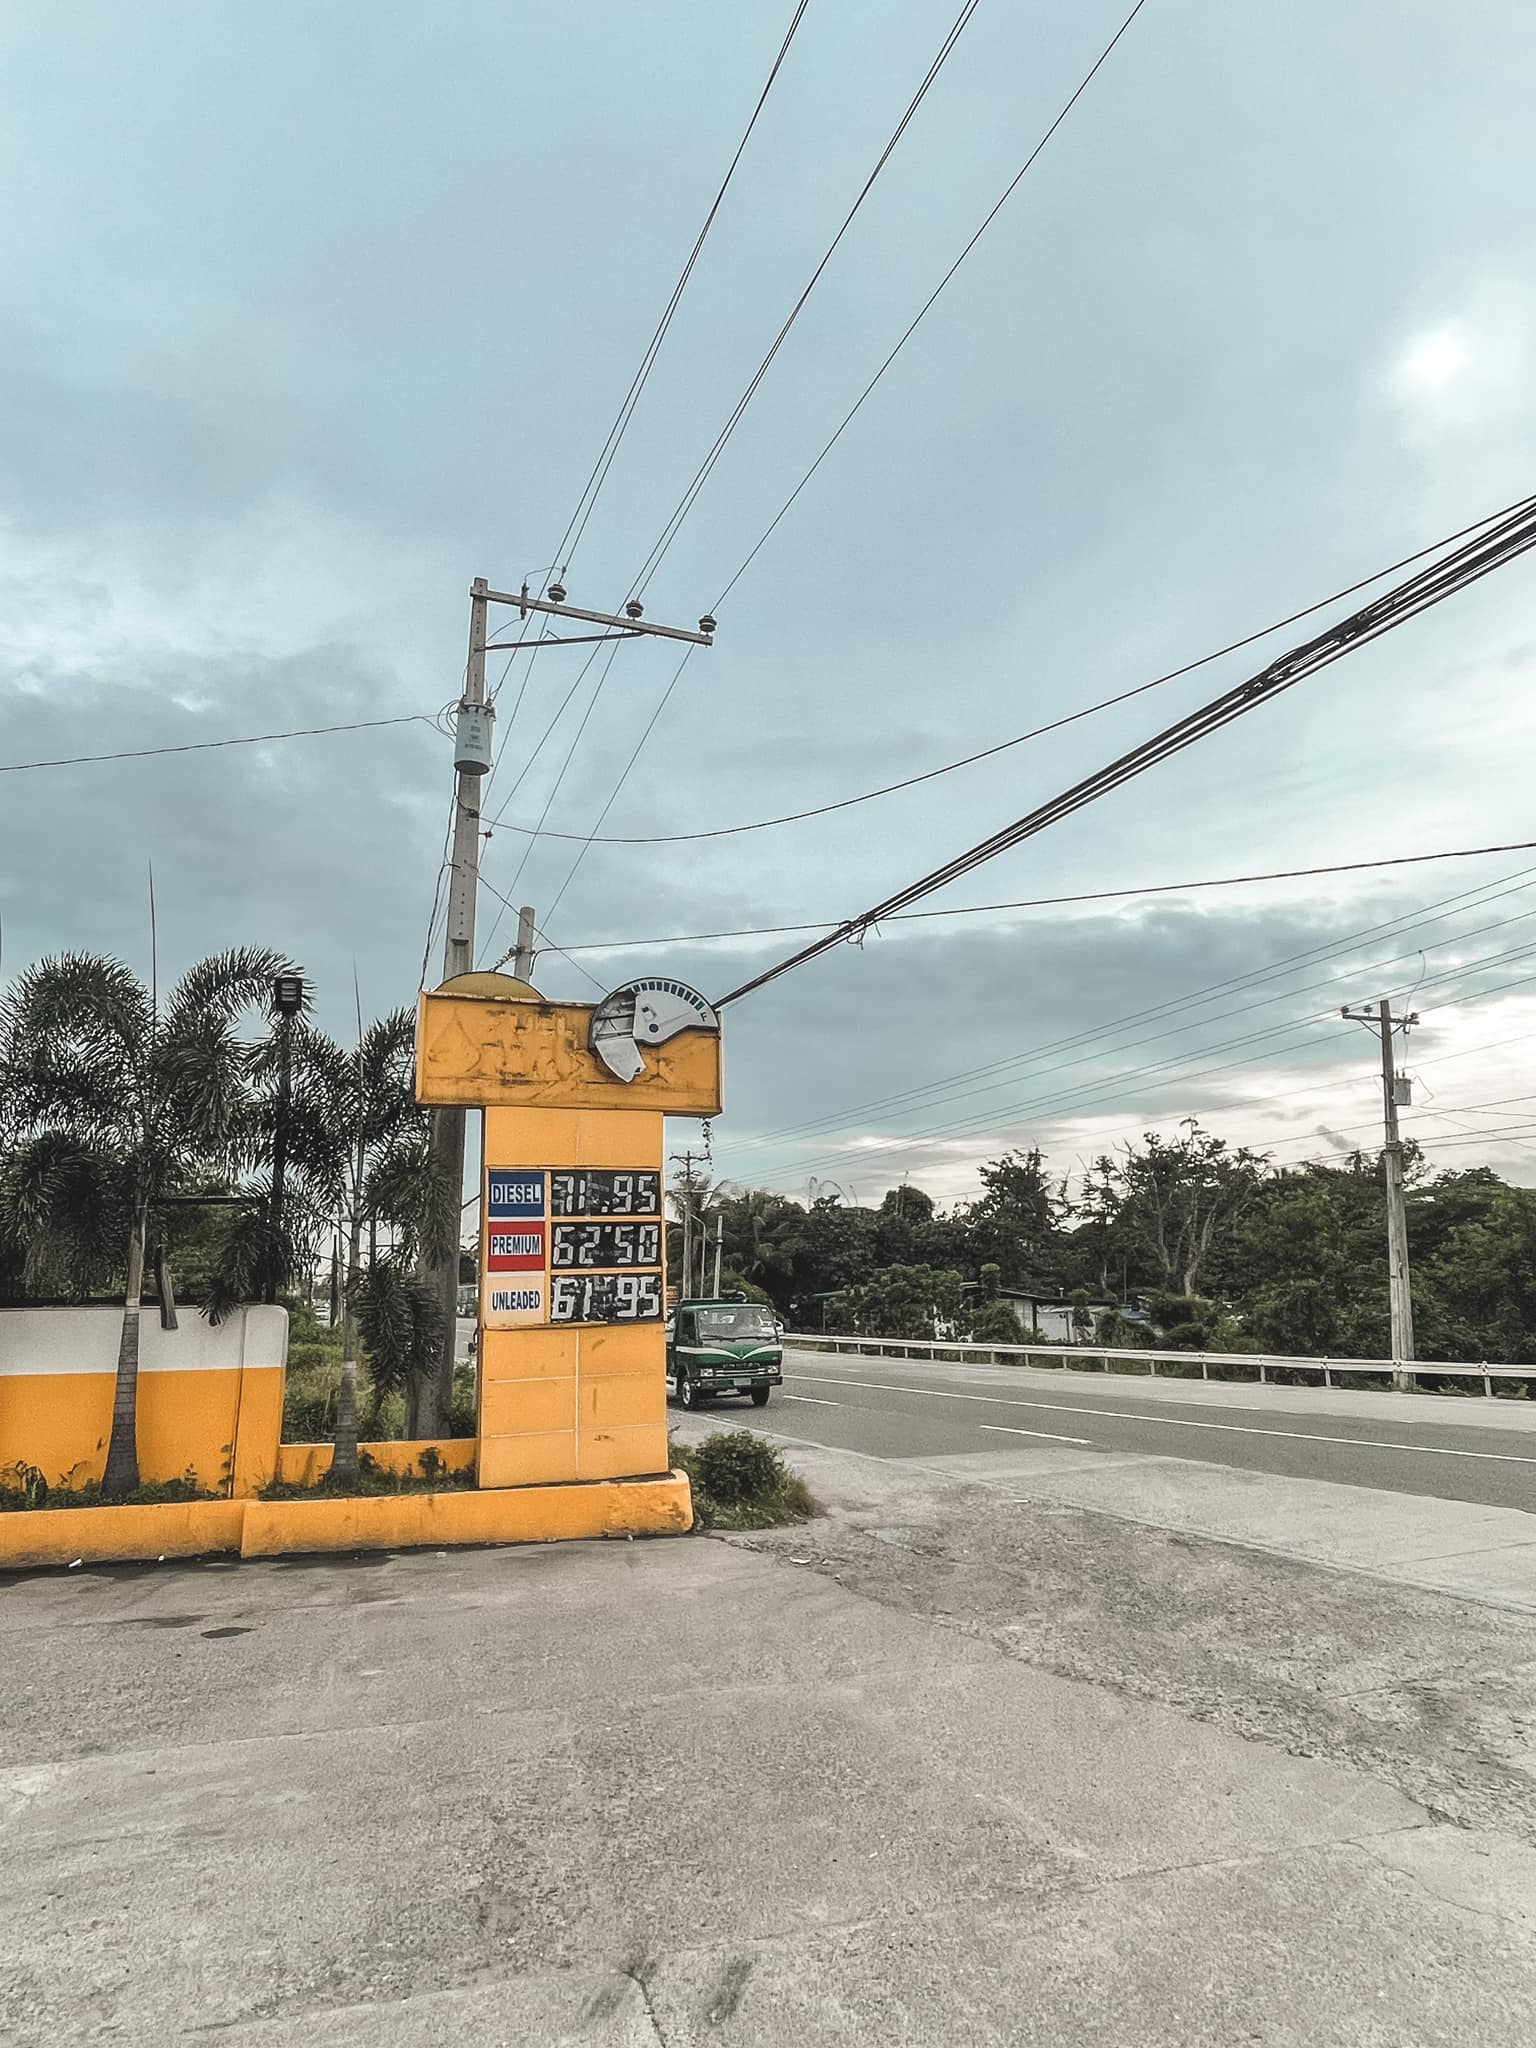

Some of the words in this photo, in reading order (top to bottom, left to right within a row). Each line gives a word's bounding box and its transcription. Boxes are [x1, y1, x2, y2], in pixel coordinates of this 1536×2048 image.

[493, 1184, 541, 1203] DIESEL
[492, 1236, 540, 1255] PREMIUM
[492, 1291, 540, 1311] UNLEADED
